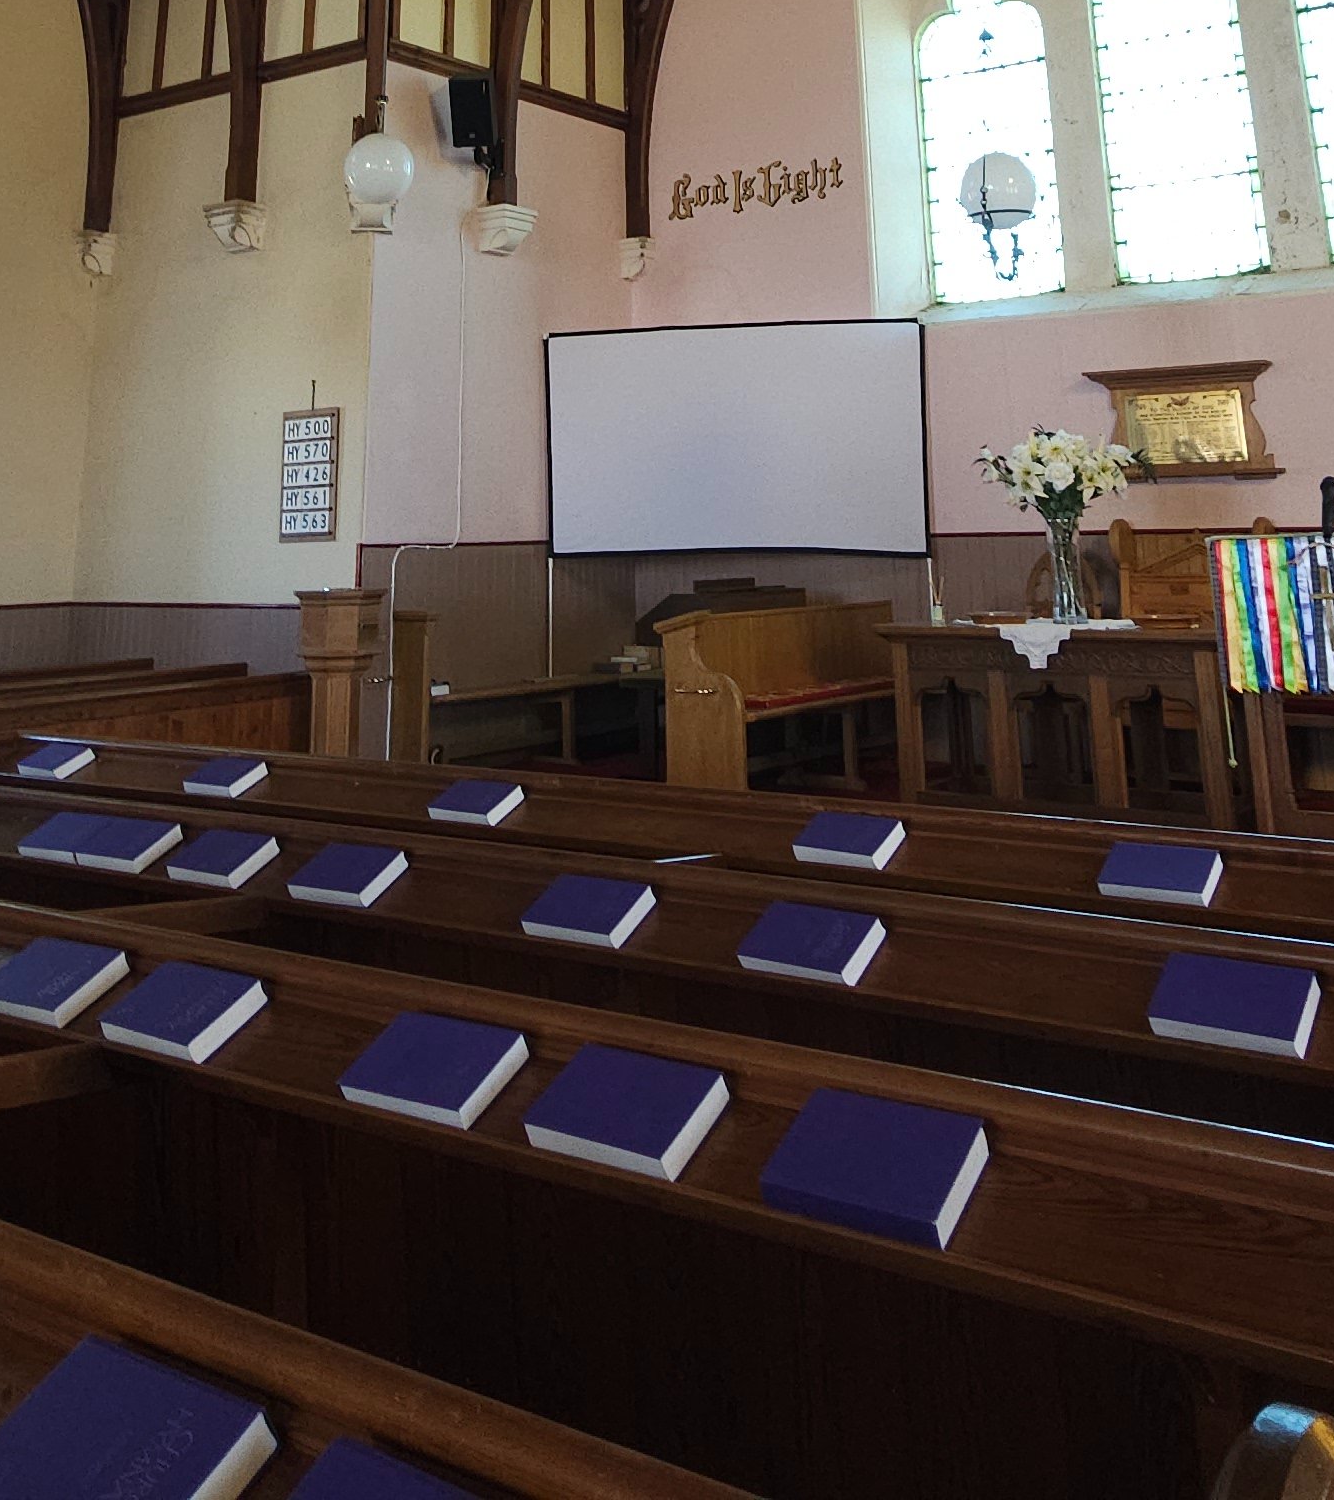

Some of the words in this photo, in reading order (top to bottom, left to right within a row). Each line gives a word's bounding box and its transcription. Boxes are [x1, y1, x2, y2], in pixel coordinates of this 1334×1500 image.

[669, 173, 729, 220] God
[731, 170, 756, 214] Is
[757, 156, 844, 207] Light
[288, 422, 301, 439] HY
[304, 419, 329, 436] 500
[287, 446, 300, 461] HY
[304, 443, 328, 459] 570
[286, 469, 300, 484] HY
[304, 467, 328, 482] 426
[285, 492, 299, 507] HY
[303, 491, 327, 506] 561
[285, 515, 298, 530] HY
[301, 514, 327, 529] 563
